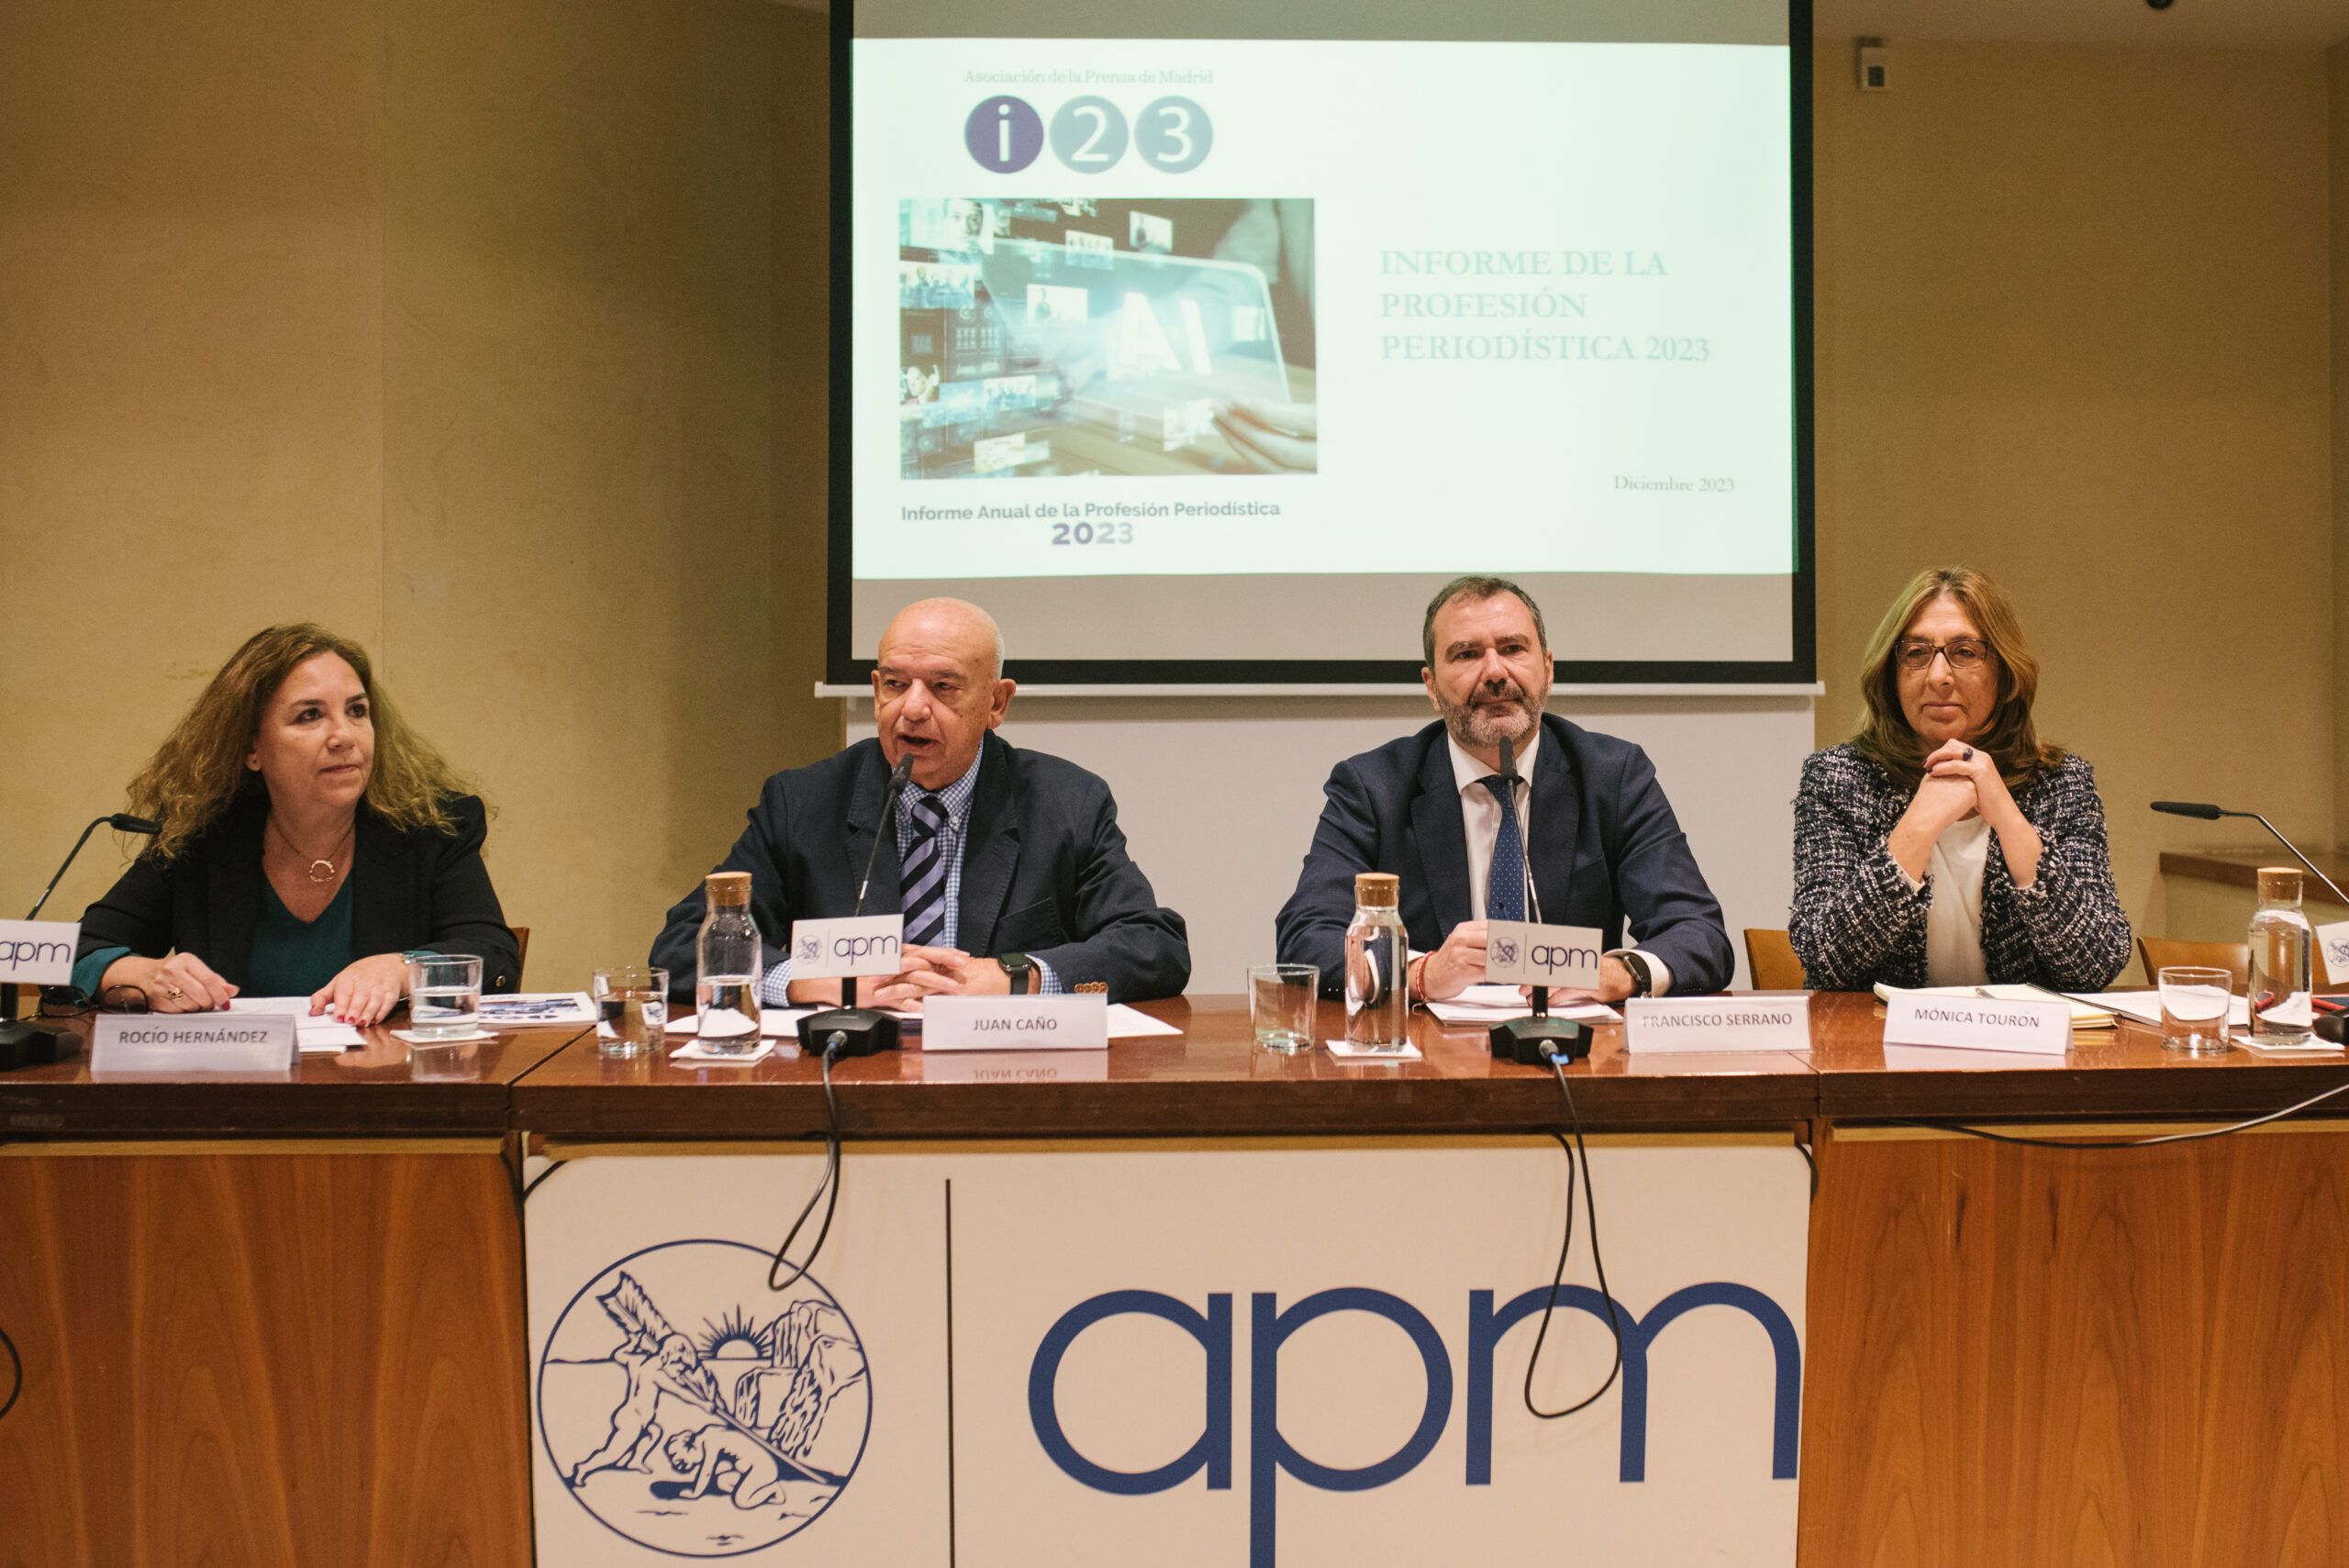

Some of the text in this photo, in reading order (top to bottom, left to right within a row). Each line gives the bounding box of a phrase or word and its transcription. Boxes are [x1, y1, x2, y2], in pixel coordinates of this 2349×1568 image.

[963, 68, 1213, 84] Asociación de la Prensa de Madrid
[1379, 250, 1670, 276] INFORME DE LA
[1379, 286, 1587, 317] PROFESIÓN
[1381, 328, 1710, 362] PERIODÍSTICA 2023
[1615, 475, 1735, 492] Diciembre 2023
[901, 501, 1280, 521] Informe Anual de la Profesión Periodística
[1052, 522, 1134, 546] 2023
[0, 940, 71, 971] apm
[834, 935, 898, 966] apm
[1531, 945, 1598, 976] apm
[973, 1015, 1058, 1031] JUAN CAÑO
[1642, 1013, 1793, 1028] FRANCISCO SERRANO
[119, 1027, 268, 1043] ROCÍO HERNÁNDEZ
[1028, 1282, 1800, 1568] apm
